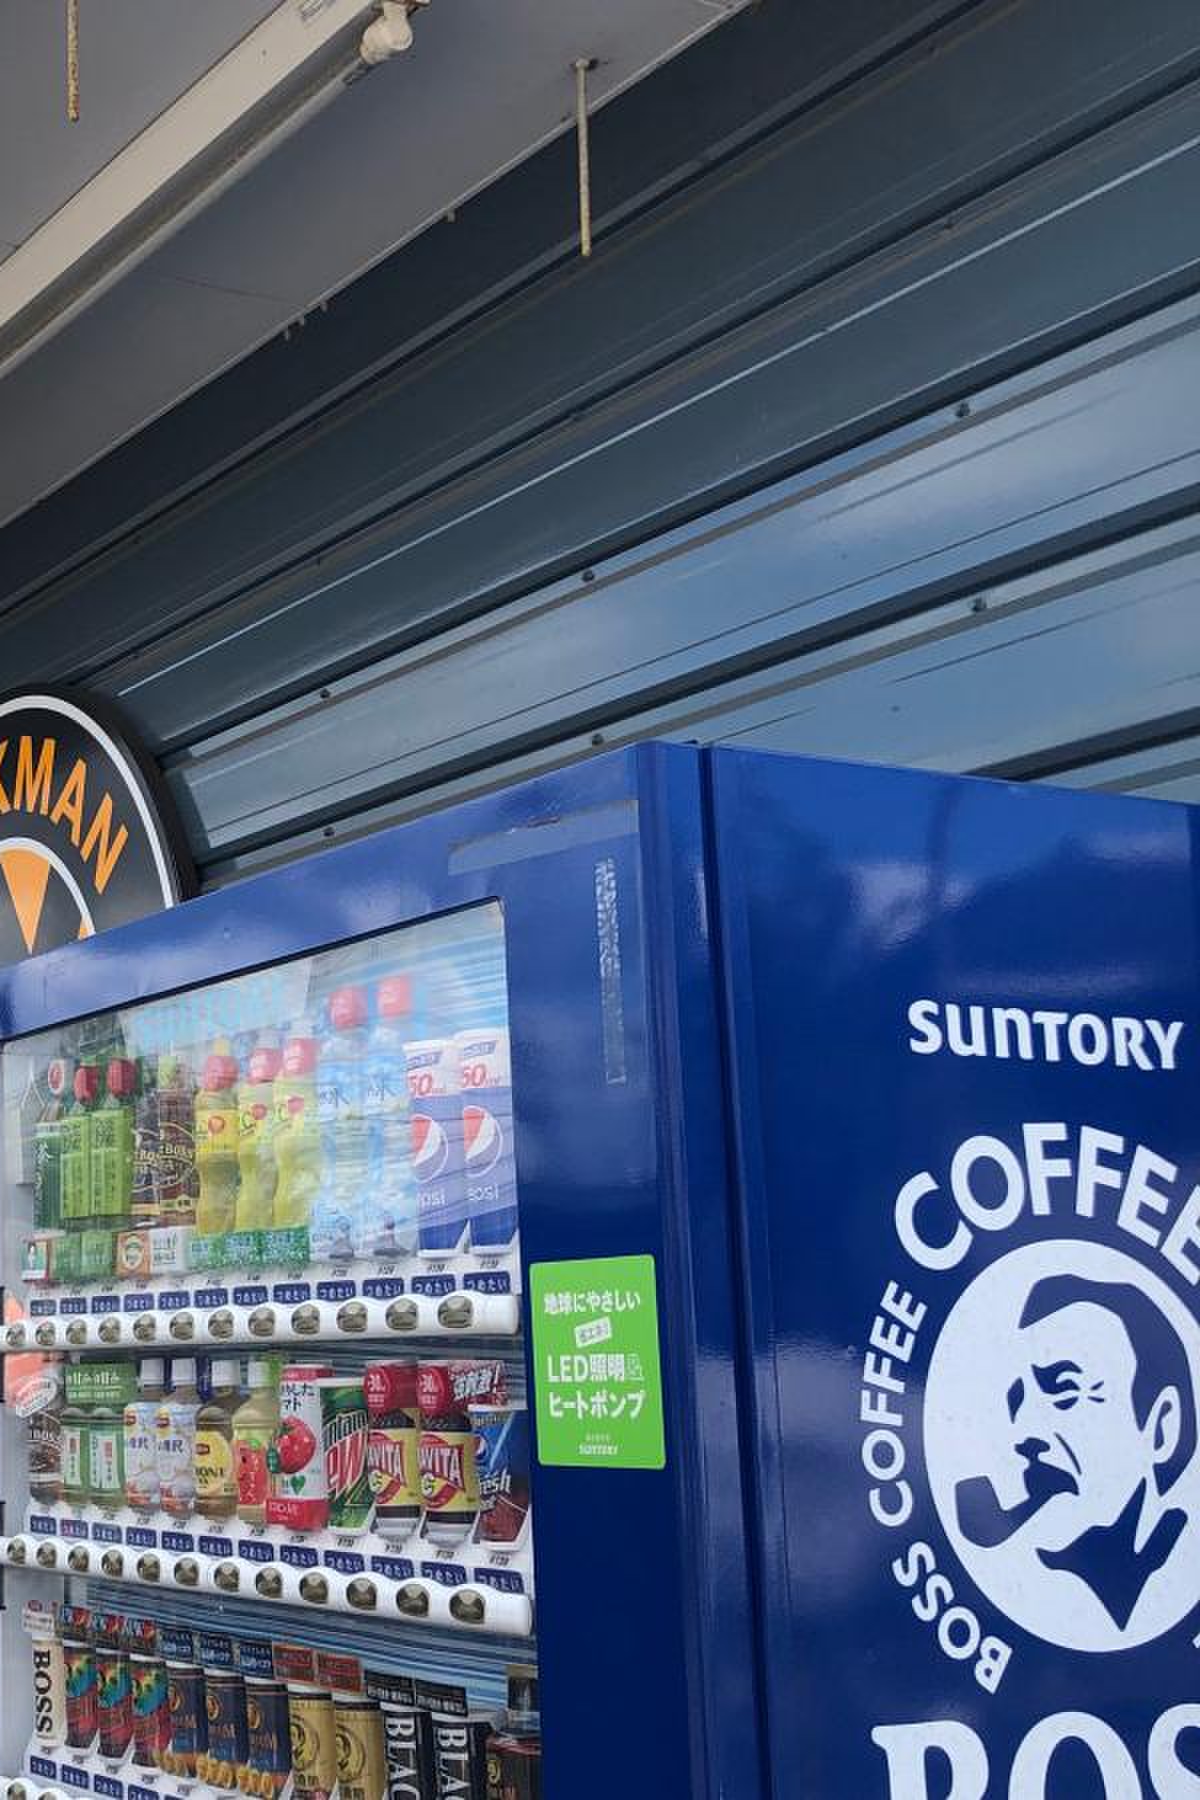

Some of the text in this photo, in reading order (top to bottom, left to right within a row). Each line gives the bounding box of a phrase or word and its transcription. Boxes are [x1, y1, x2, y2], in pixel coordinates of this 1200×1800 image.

[543, 1290, 641, 1315] 地球にやさしい
[549, 1389, 646, 1420] ヒートポンプ
[860, 1280, 1012, 1694] BOSS COFFEE
[34, 1650, 53, 1735] BOSS
[437, 1728, 470, 1800] BLA
